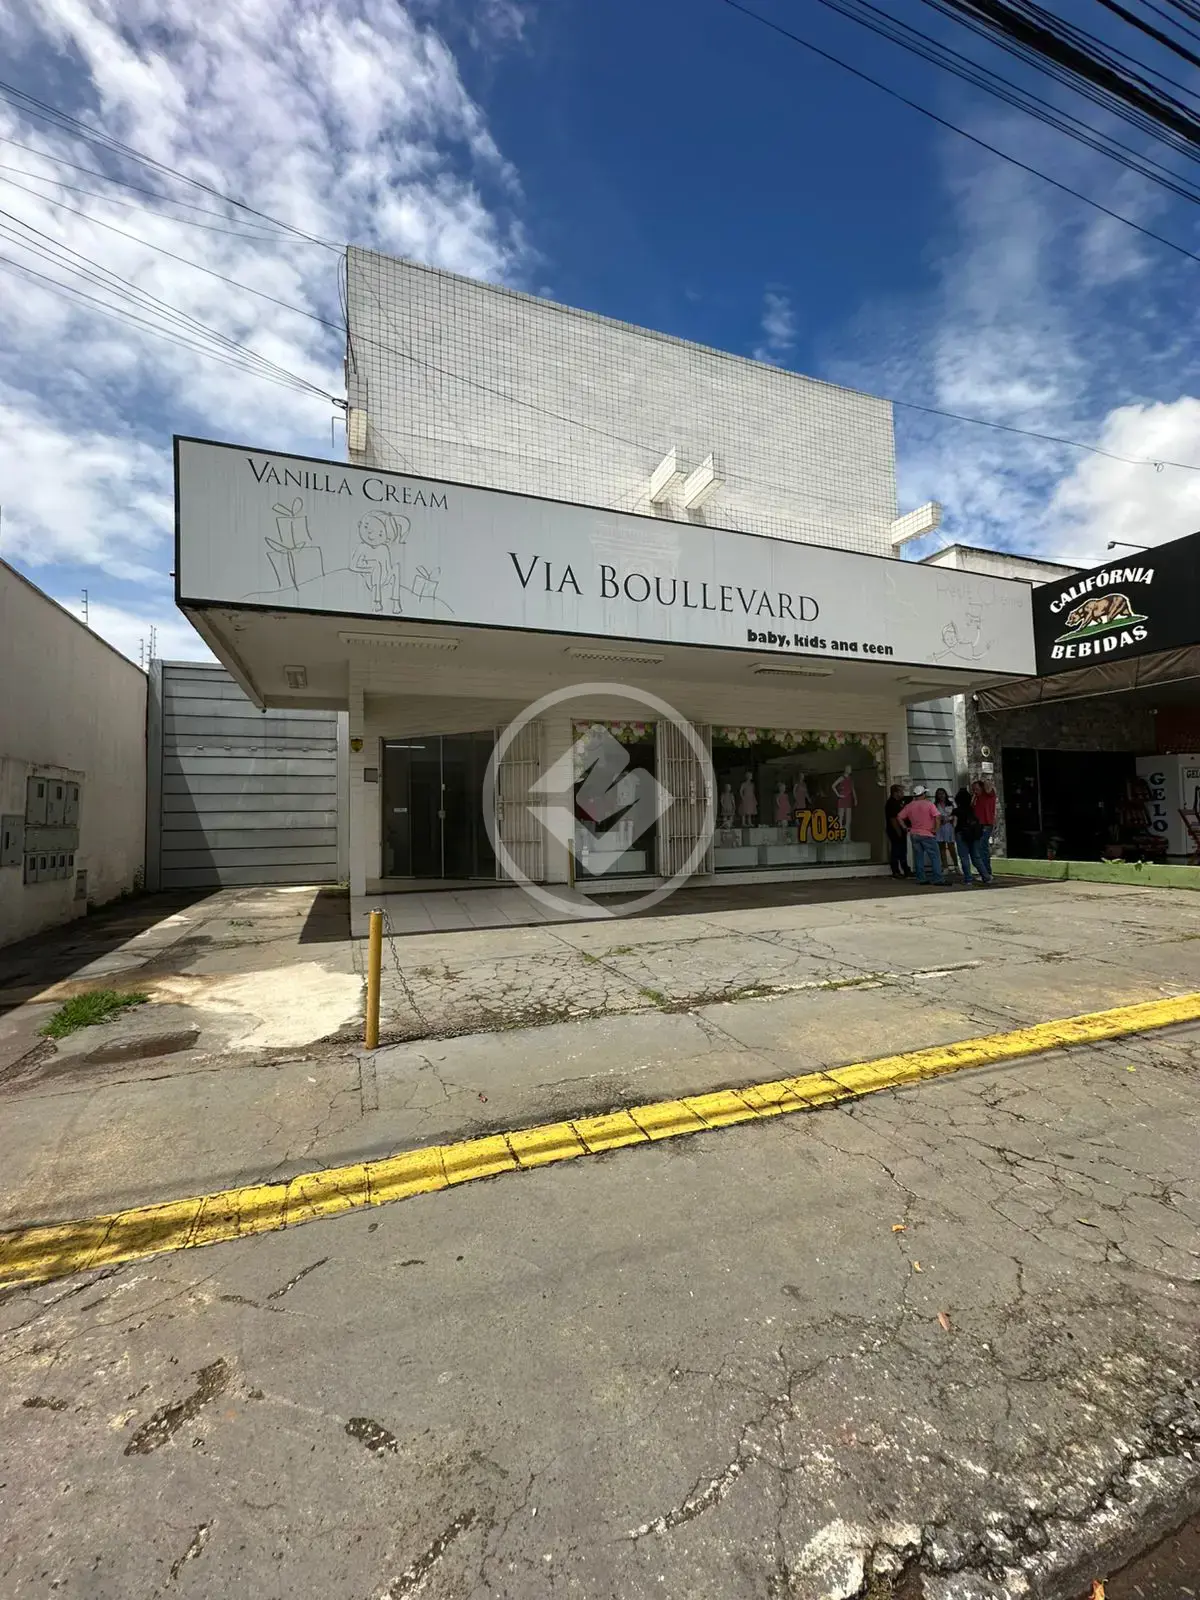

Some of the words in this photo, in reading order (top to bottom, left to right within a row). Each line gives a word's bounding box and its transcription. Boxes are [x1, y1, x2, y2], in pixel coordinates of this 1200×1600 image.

[247, 458, 352, 496] VANILLA
[362, 478, 448, 510] CREAM
[507, 551, 583, 596] VIA
[599, 564, 820, 623] BOULLEVARD
[1050, 567, 1155, 614] CALIFÓRNIA
[747, 628, 791, 648] baby,
[794, 633, 827, 649] kids
[862, 642, 893, 656] teen
[1050, 625, 1148, 660] BEBIDAS
[1149, 772, 1169, 832] GELO
[828, 829, 846, 841] OFF
